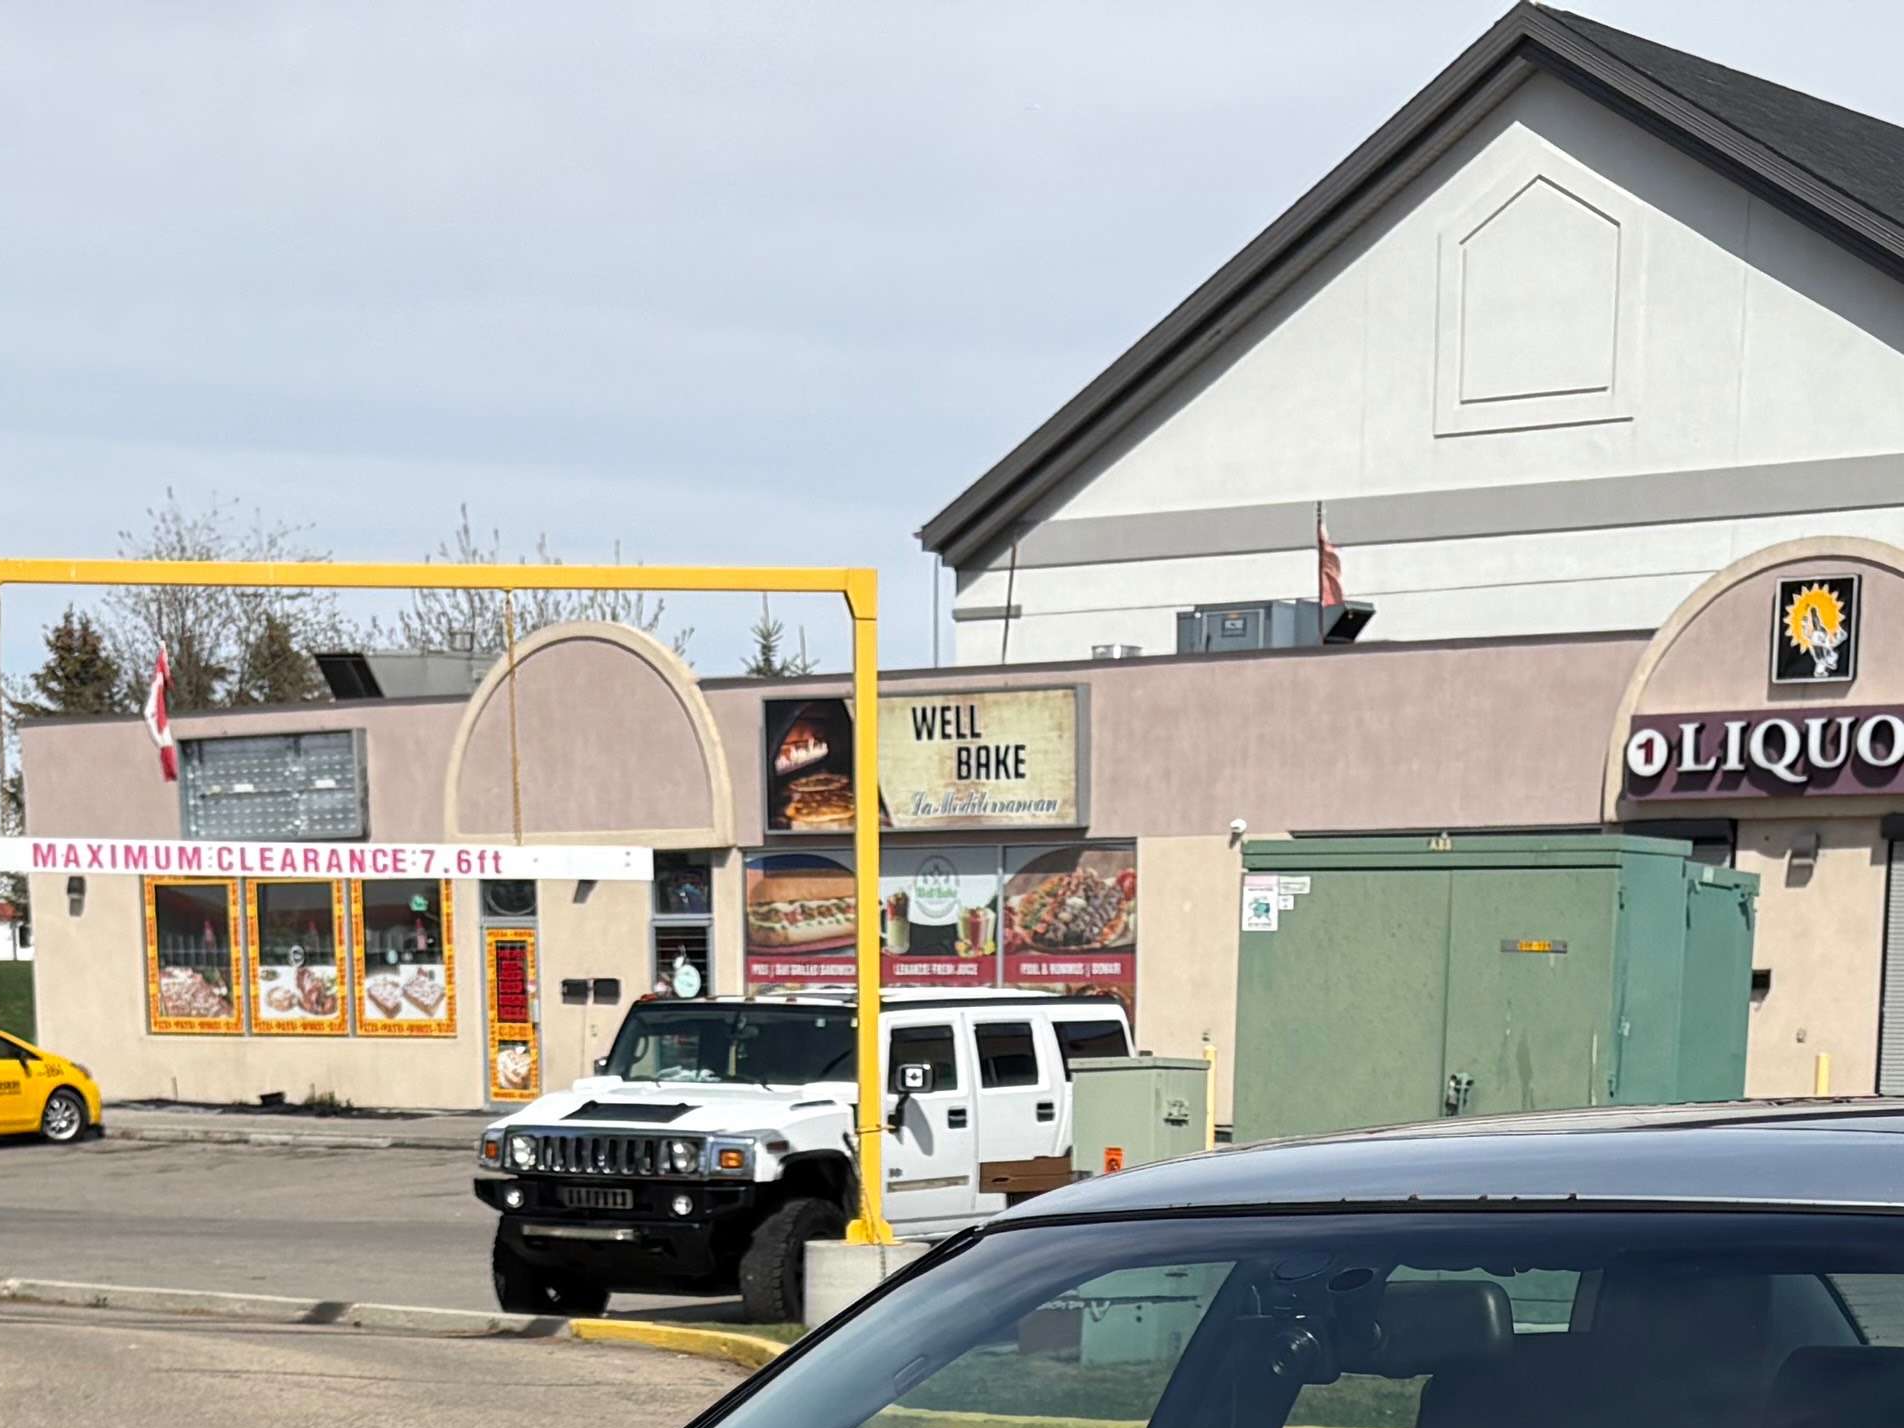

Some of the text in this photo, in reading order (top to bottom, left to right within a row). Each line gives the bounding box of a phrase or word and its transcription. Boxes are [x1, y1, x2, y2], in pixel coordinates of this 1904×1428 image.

[912, 705, 982, 741] WELL
[957, 744, 1027, 781] BAKE
[32, 842, 504, 875] MAXIMUM CLEARANCE 7.6ft
